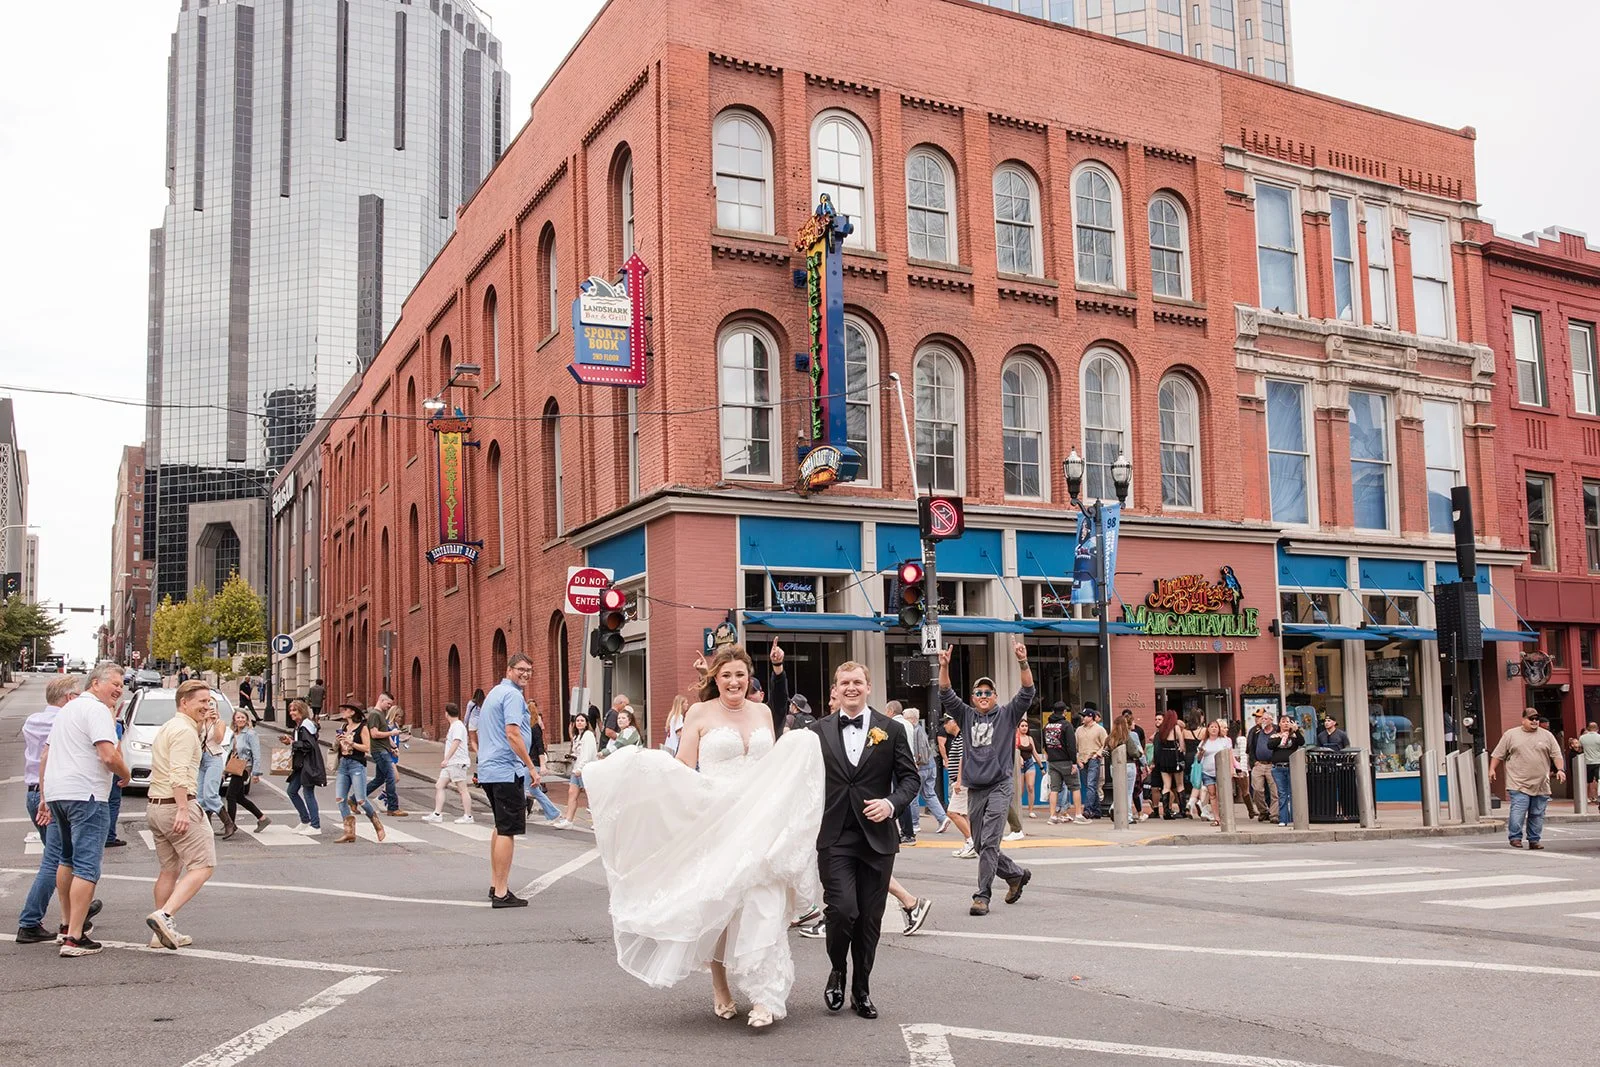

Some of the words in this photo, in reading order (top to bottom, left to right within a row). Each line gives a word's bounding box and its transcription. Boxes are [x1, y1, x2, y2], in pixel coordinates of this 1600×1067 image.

[583, 304, 629, 315] LANDSHARK
[584, 327, 626, 340] SPORTS
[589, 338, 619, 350] BOOK
[443, 435, 458, 540] MARGARITAVILLE
[1106, 517, 1117, 528] 98
[574, 576, 587, 584] DO
[589, 577, 607, 586] NOT
[575, 596, 600, 606] ENTER
[776, 591, 816, 602] ULTRA
[1124, 604, 1260, 636] MARGARITAVILLE
[1139, 640, 1208, 650] RESTAURANT
[1225, 641, 1248, 650] BAR
